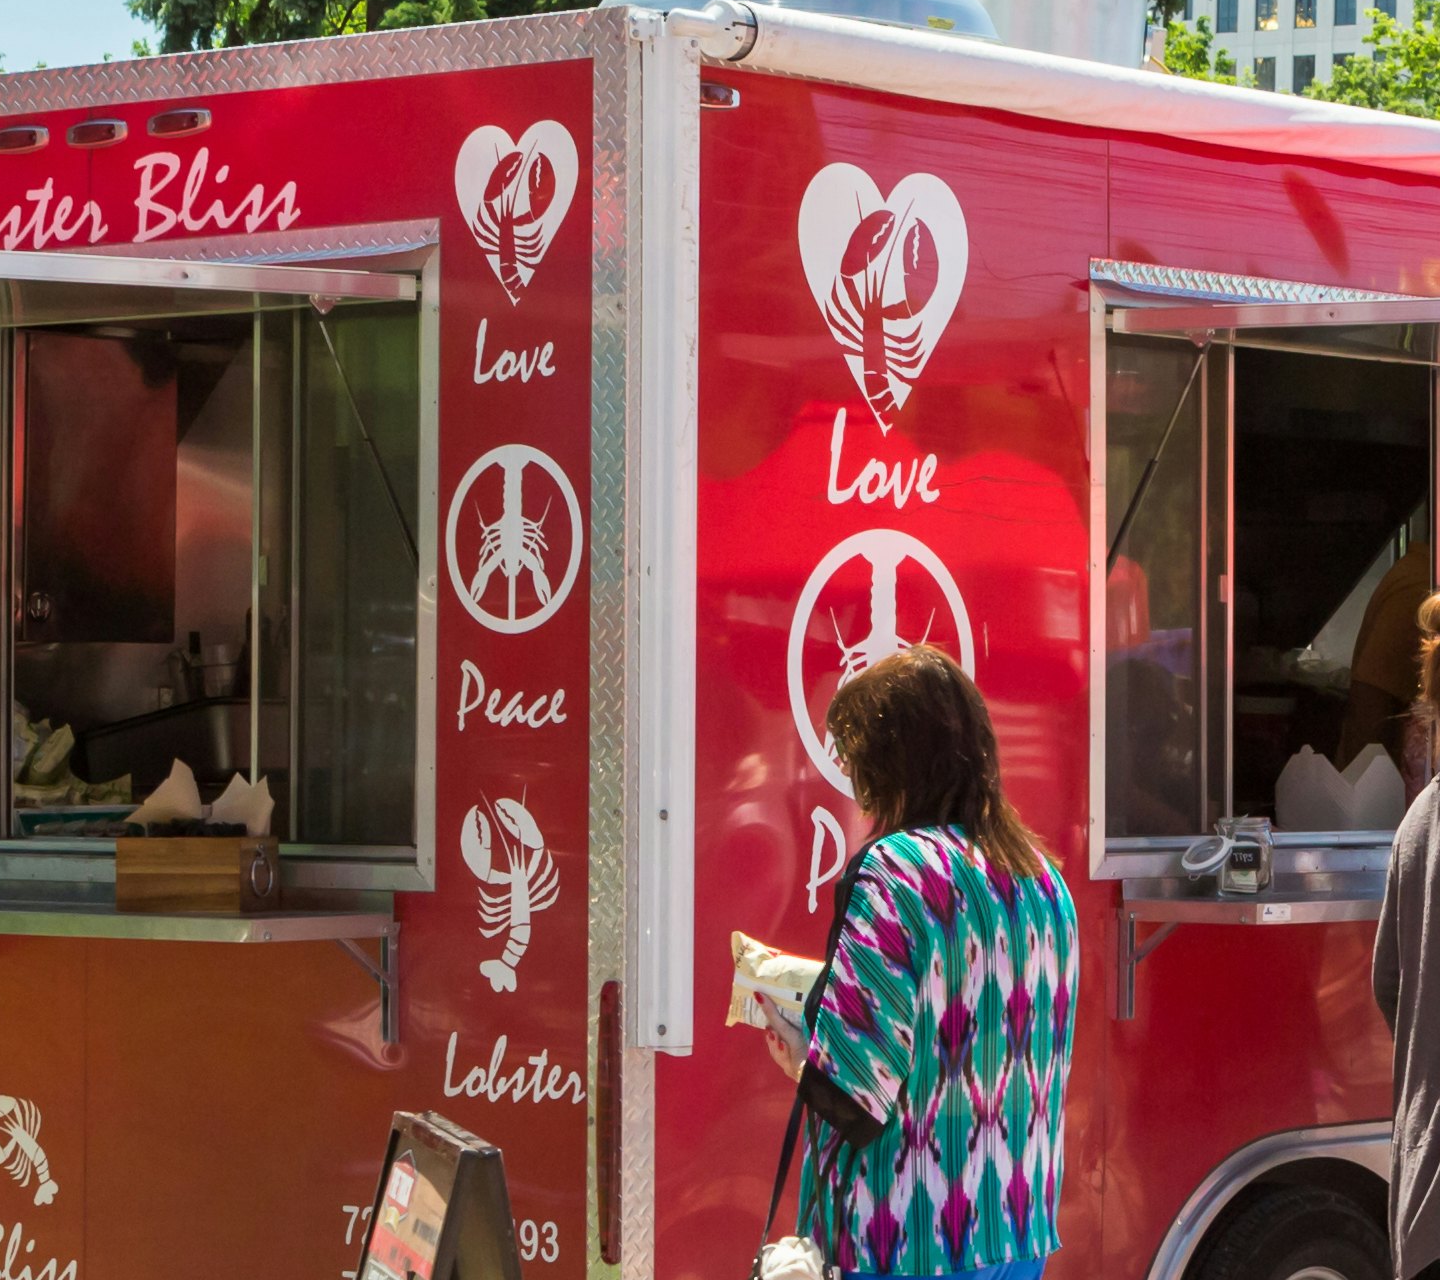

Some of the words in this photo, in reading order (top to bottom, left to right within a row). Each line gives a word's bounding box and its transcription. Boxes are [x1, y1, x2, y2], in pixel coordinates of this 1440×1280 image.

[133, 147, 301, 243] Bliss
[473, 318, 556, 385] Love
[827, 407, 940, 509] Love
[457, 659, 567, 731] Peace
[444, 1031, 586, 1105] Lobster
